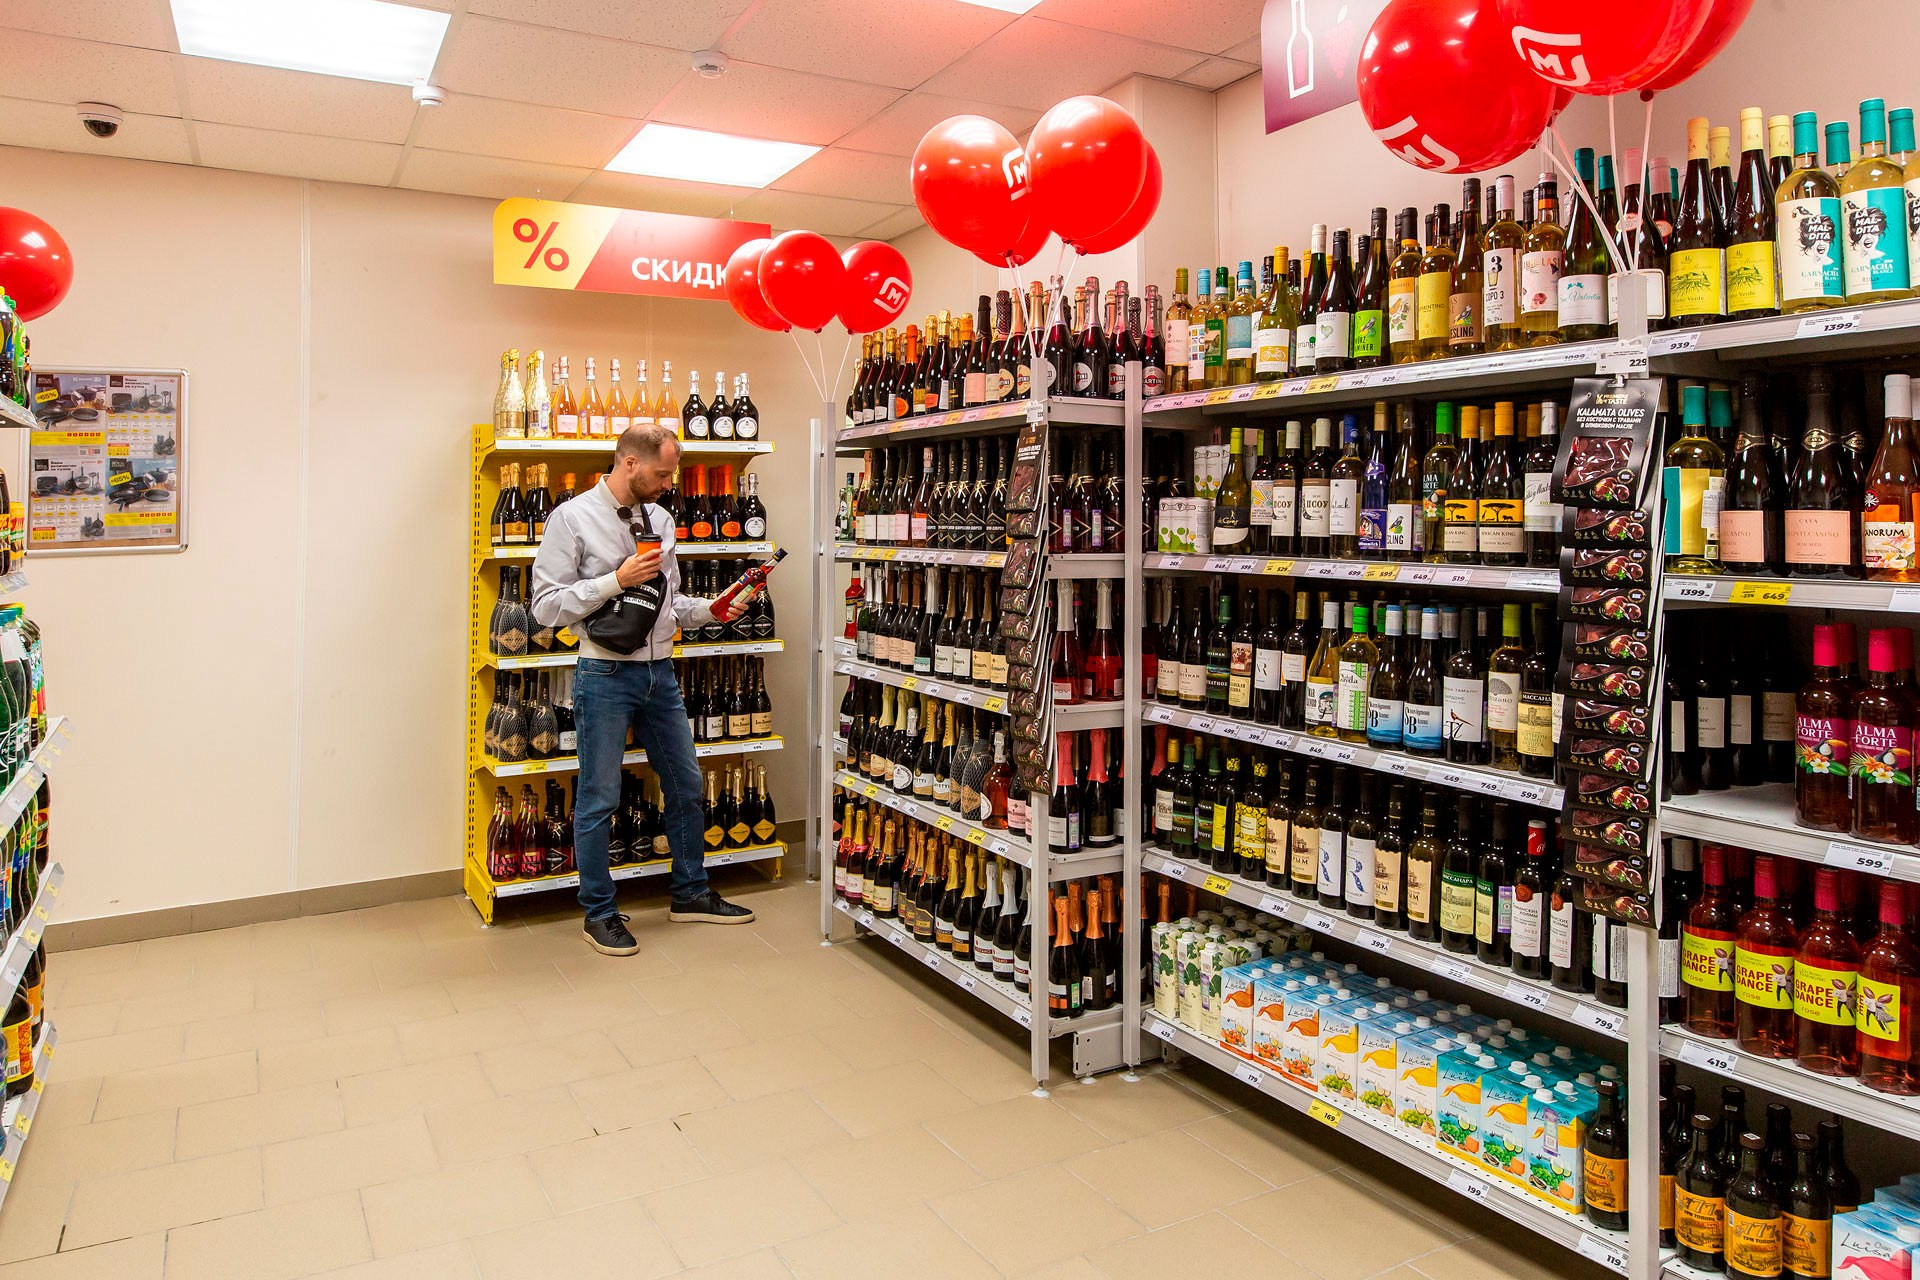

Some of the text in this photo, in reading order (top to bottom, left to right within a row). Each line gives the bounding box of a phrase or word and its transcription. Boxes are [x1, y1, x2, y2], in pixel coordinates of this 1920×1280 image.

[1855, 209, 1868, 217] LA
[1808, 232, 1831, 240] DITA
[1855, 226, 1880, 235] DITA
[631, 257, 727, 288] СКИДК
[1450, 326, 1474, 339] ESLING
[1824, 322, 1854, 332] 1399
[1670, 342, 1690, 350] 939
[1628, 358, 1648, 368] 229
[1577, 408, 1645, 417] KALAMATA OLIVES
[1423, 474, 1438, 482] LMA
[1680, 588, 1706, 598] 1399
[1762, 592, 1786, 600] 649
[1797, 717, 1832, 730] ALMA
[1797, 728, 1833, 739] FORTE
[1856, 725, 1896, 738] ALMA
[1856, 734, 1897, 748] FORTE
[1338, 752, 1352, 761] 549
[1480, 782, 1498, 792] 749
[1520, 790, 1538, 800] 599
[1856, 856, 1884, 870] 599
[1316, 920, 1330, 930] 399
[1370, 940, 1386, 950] 399
[1683, 948, 1715, 966] GRAPE
[1683, 959, 1715, 976] DANCE
[1736, 964, 1773, 983] GRAPE
[1736, 974, 1773, 993] DANCE
[1795, 979, 1833, 998] GRAPE
[1524, 994, 1540, 1006] 279
[1795, 989, 1834, 1008] DANCE
[1594, 1016, 1612, 1030] 799
[1706, 1058, 1728, 1070] 419
[1247, 1074, 1258, 1083] 179
[1324, 1112, 1336, 1122] 169
[1466, 1184, 1482, 1196] 199
[1840, 1233, 1894, 1259] Luisa
[1606, 1254, 1622, 1266] 119
